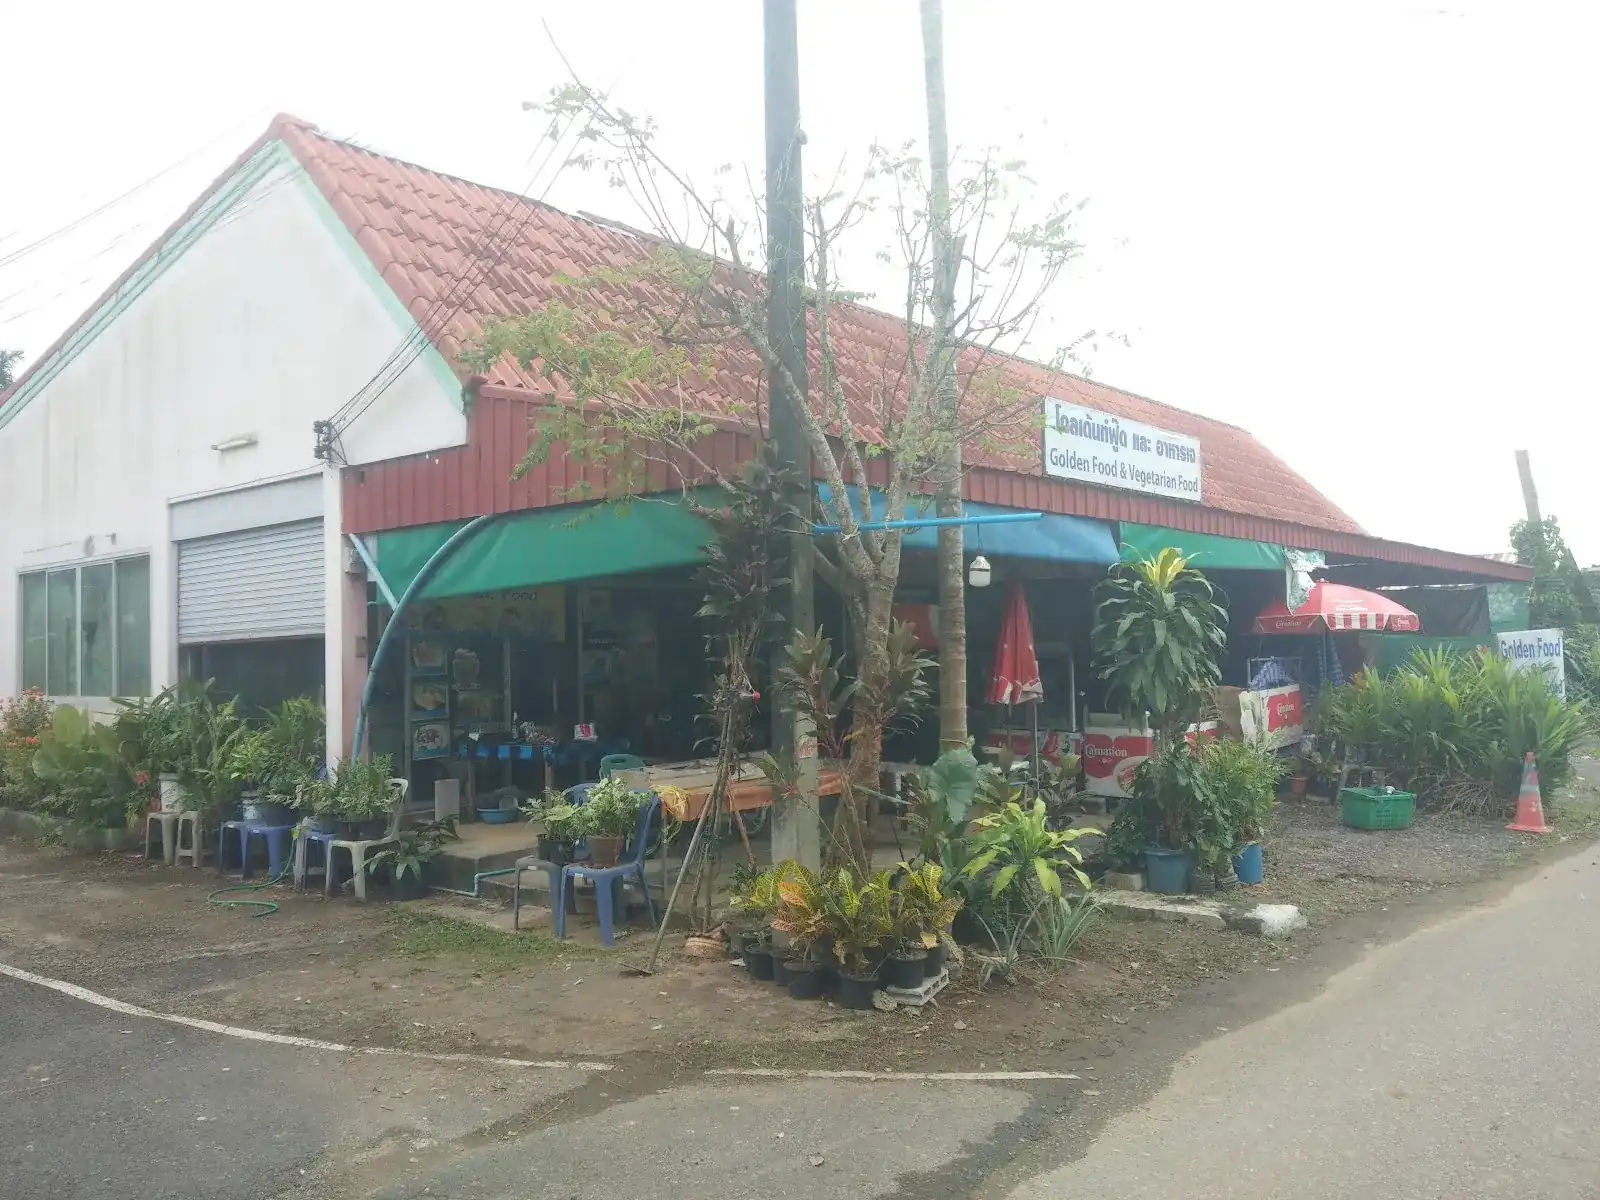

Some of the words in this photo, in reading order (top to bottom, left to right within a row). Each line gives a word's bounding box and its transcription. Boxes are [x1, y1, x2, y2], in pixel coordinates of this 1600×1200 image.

[1133, 432, 1152, 452] และ
[1156, 439, 1196, 463] อาหารเจ
[1049, 447, 1090, 472] Golden
[1093, 456, 1118, 478] Food
[1120, 461, 1127, 479] &
[1128, 463, 1177, 489] Vegetarian
[1179, 474, 1199, 493] Food
[1500, 639, 1535, 659] Golden
[1537, 637, 1561, 657] Food
[1085, 744, 1128, 758] Carnation
